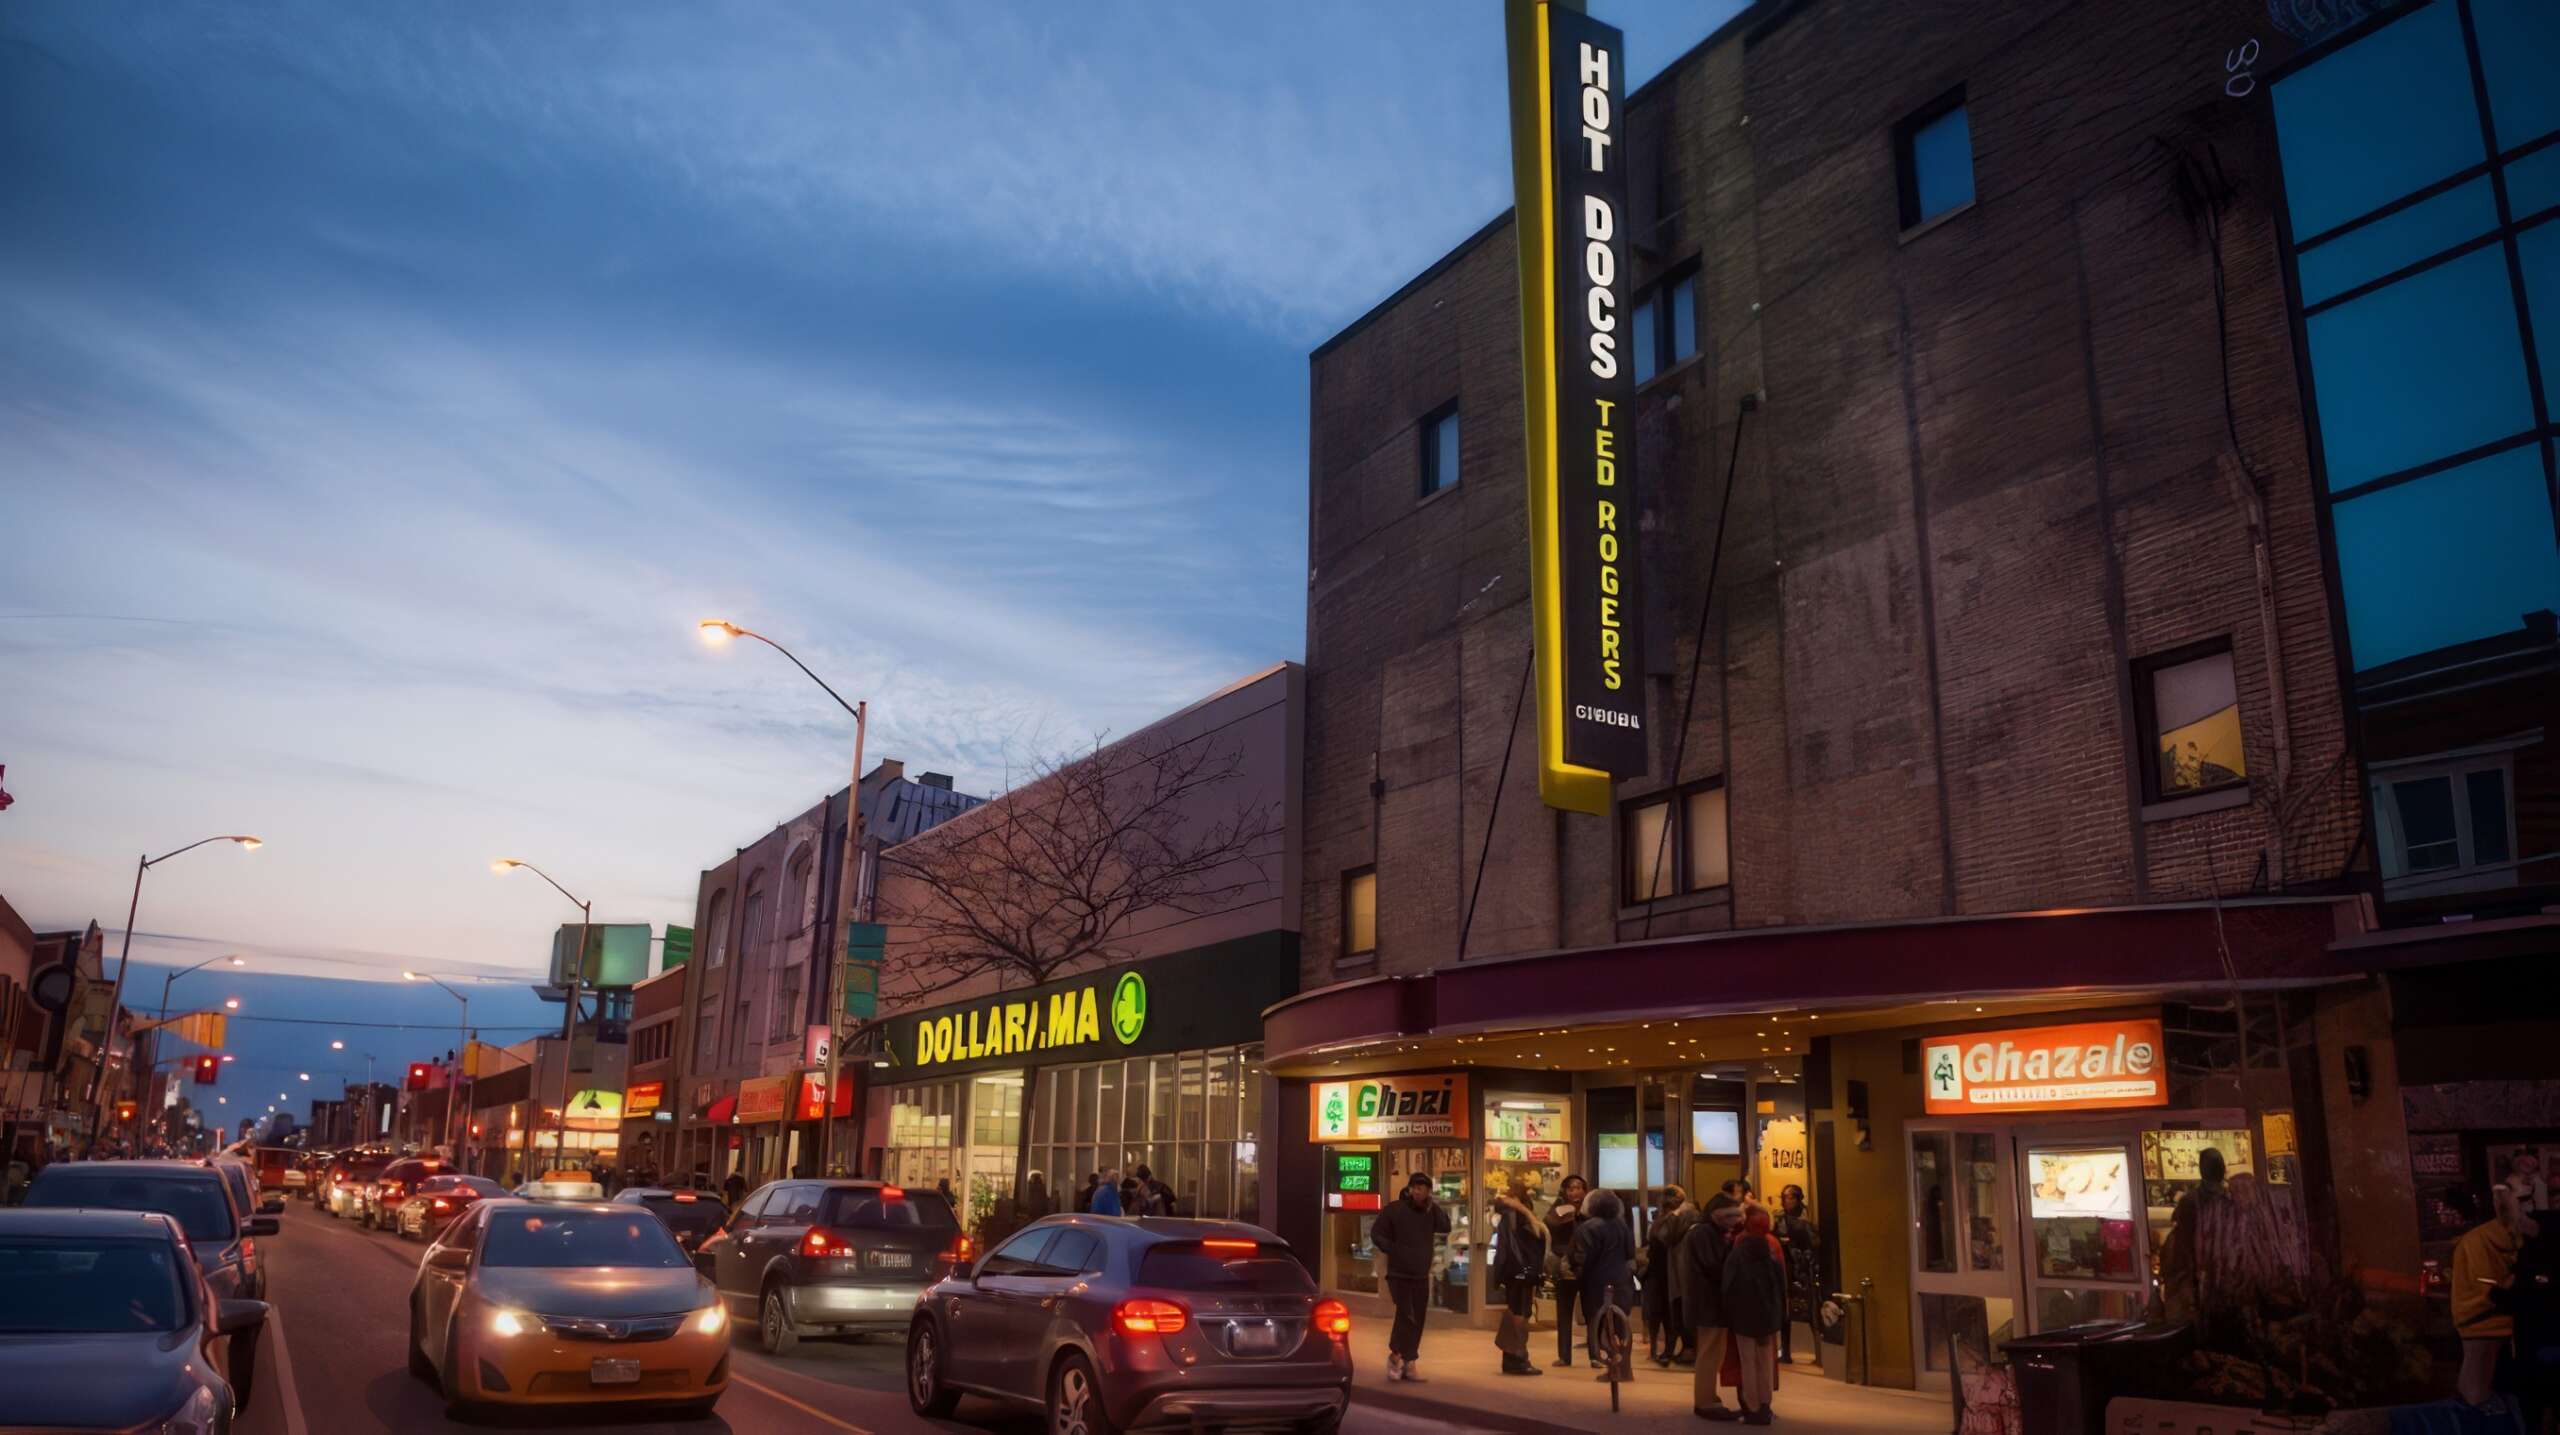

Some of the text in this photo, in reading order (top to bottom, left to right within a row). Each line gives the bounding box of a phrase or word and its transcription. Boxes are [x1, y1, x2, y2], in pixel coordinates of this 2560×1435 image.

[1580, 42, 1617, 379] HOT DOCS
[1595, 399, 1621, 690] TED ROGERS
[1356, 1077, 1454, 1118] Ghazi
[1963, 1033, 2154, 1083] Ghazale
